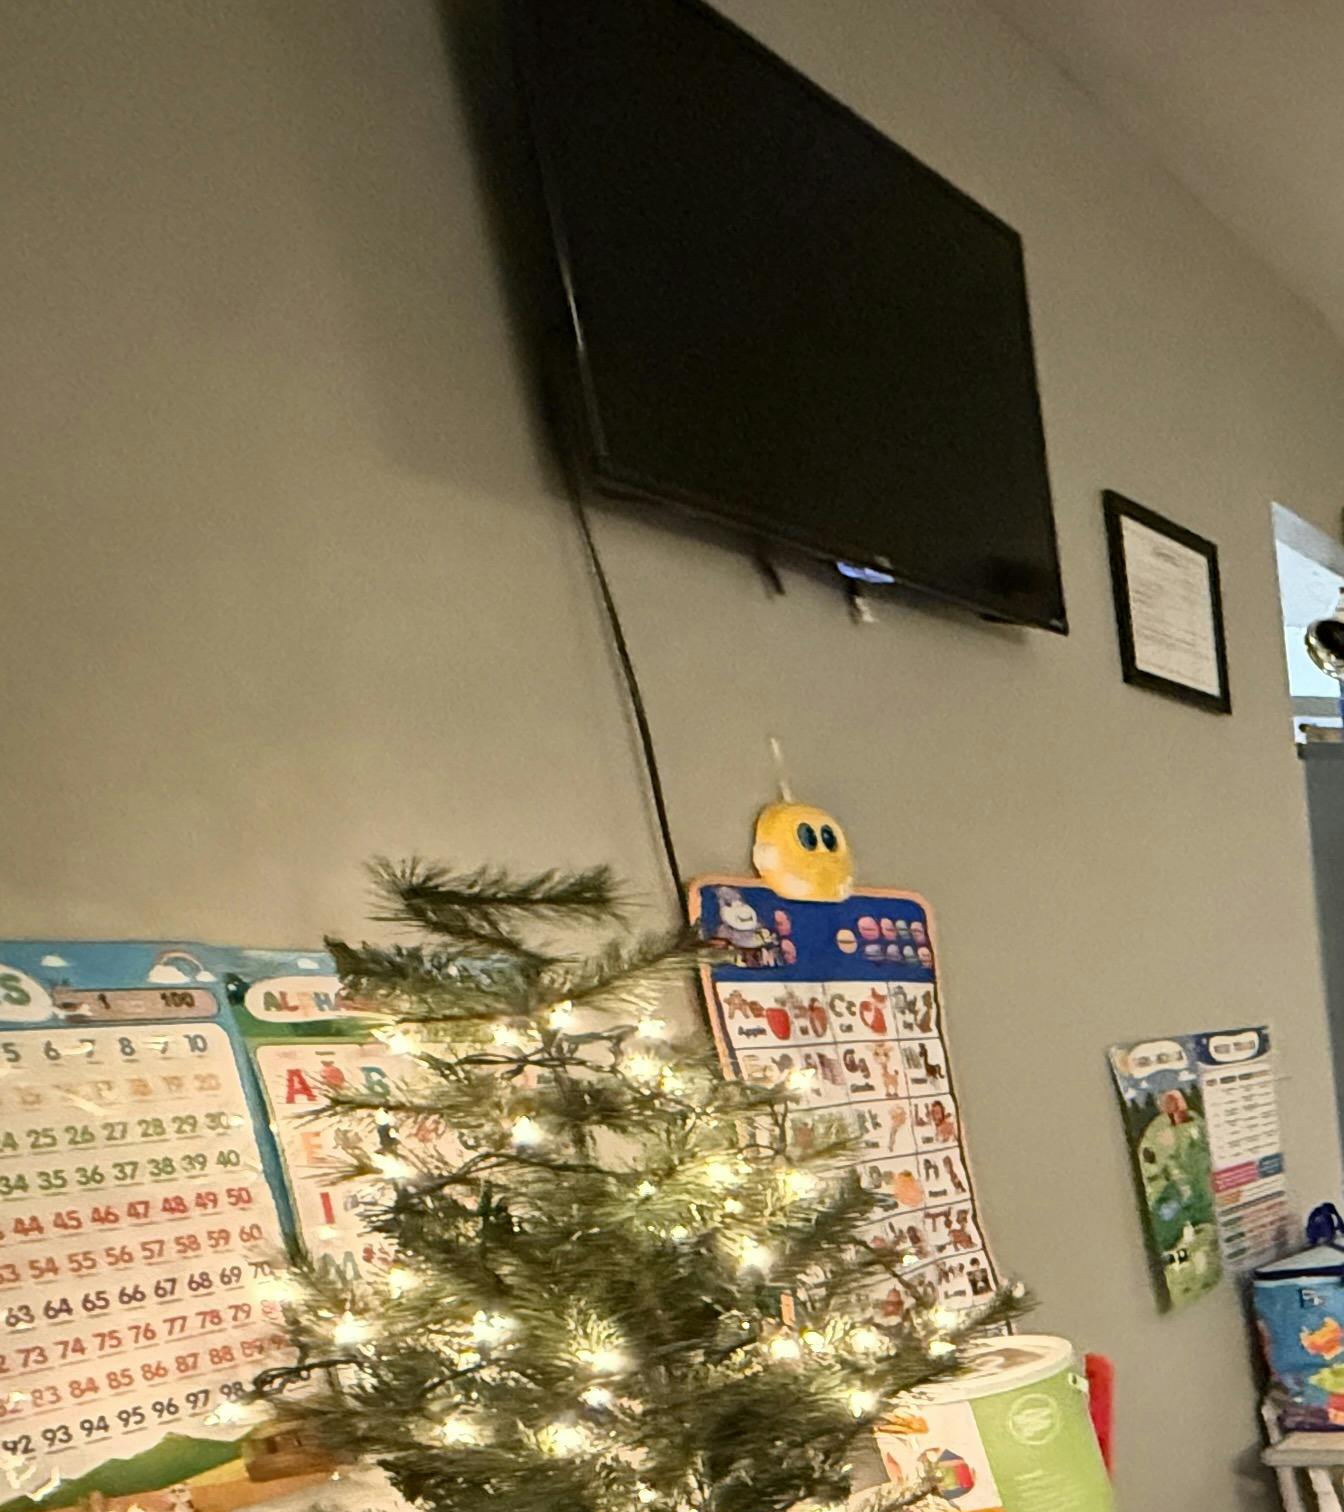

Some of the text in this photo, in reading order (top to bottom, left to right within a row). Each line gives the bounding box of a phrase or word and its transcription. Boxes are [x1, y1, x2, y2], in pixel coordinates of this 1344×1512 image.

[160, 991, 195, 1008] 100
[1, 1042, 21, 1062] 5
[44, 1040, 62, 1060] 6
[117, 1036, 136, 1056] 8
[183, 1033, 208, 1053] 10
[284, 1068, 317, 1104] A
[0, 1112, 232, 1151] 4 25 26 27 28 29 30
[37, 1169, 68, 1191] 35
[75, 1166, 106, 1186] 36
[112, 1160, 139, 1181] 37
[149, 1156, 177, 1177] 38
[181, 1153, 208, 1173] 39
[215, 1149, 241, 1169] 40
[12, 1186, 253, 1237] 44 45 46 47 48 49 50
[28, 1257, 60, 1280] 54
[67, 1251, 97, 1274] 55
[104, 1246, 134, 1267] 56
[140, 1240, 166, 1261] 57
[174, 1234, 201, 1255] 58
[206, 1229, 231, 1249] 59
[239, 1223, 263, 1243] 60
[5, 1260, 273, 1329] 63 64 65 66 67 68 69 70
[15, 1345, 49, 1369] 73
[53, 1337, 87, 1361] 74
[92, 1330, 123, 1351] 75
[127, 1322, 157, 1344] 76
[162, 1315, 188, 1337] 77
[194, 1309, 223, 1330] 78
[227, 1302, 252, 1323] 79
[30, 1384, 62, 1408] 83
[68, 1376, 100, 1399] 84
[105, 1368, 135, 1391] 85
[140, 1360, 169, 1381] 86
[174, 1352, 200, 1374] 87
[207, 1345, 235, 1366] 88
[240, 1338, 265, 1358] 89
[2, 1381, 246, 1456] 92 93 94 95 96 97 98
